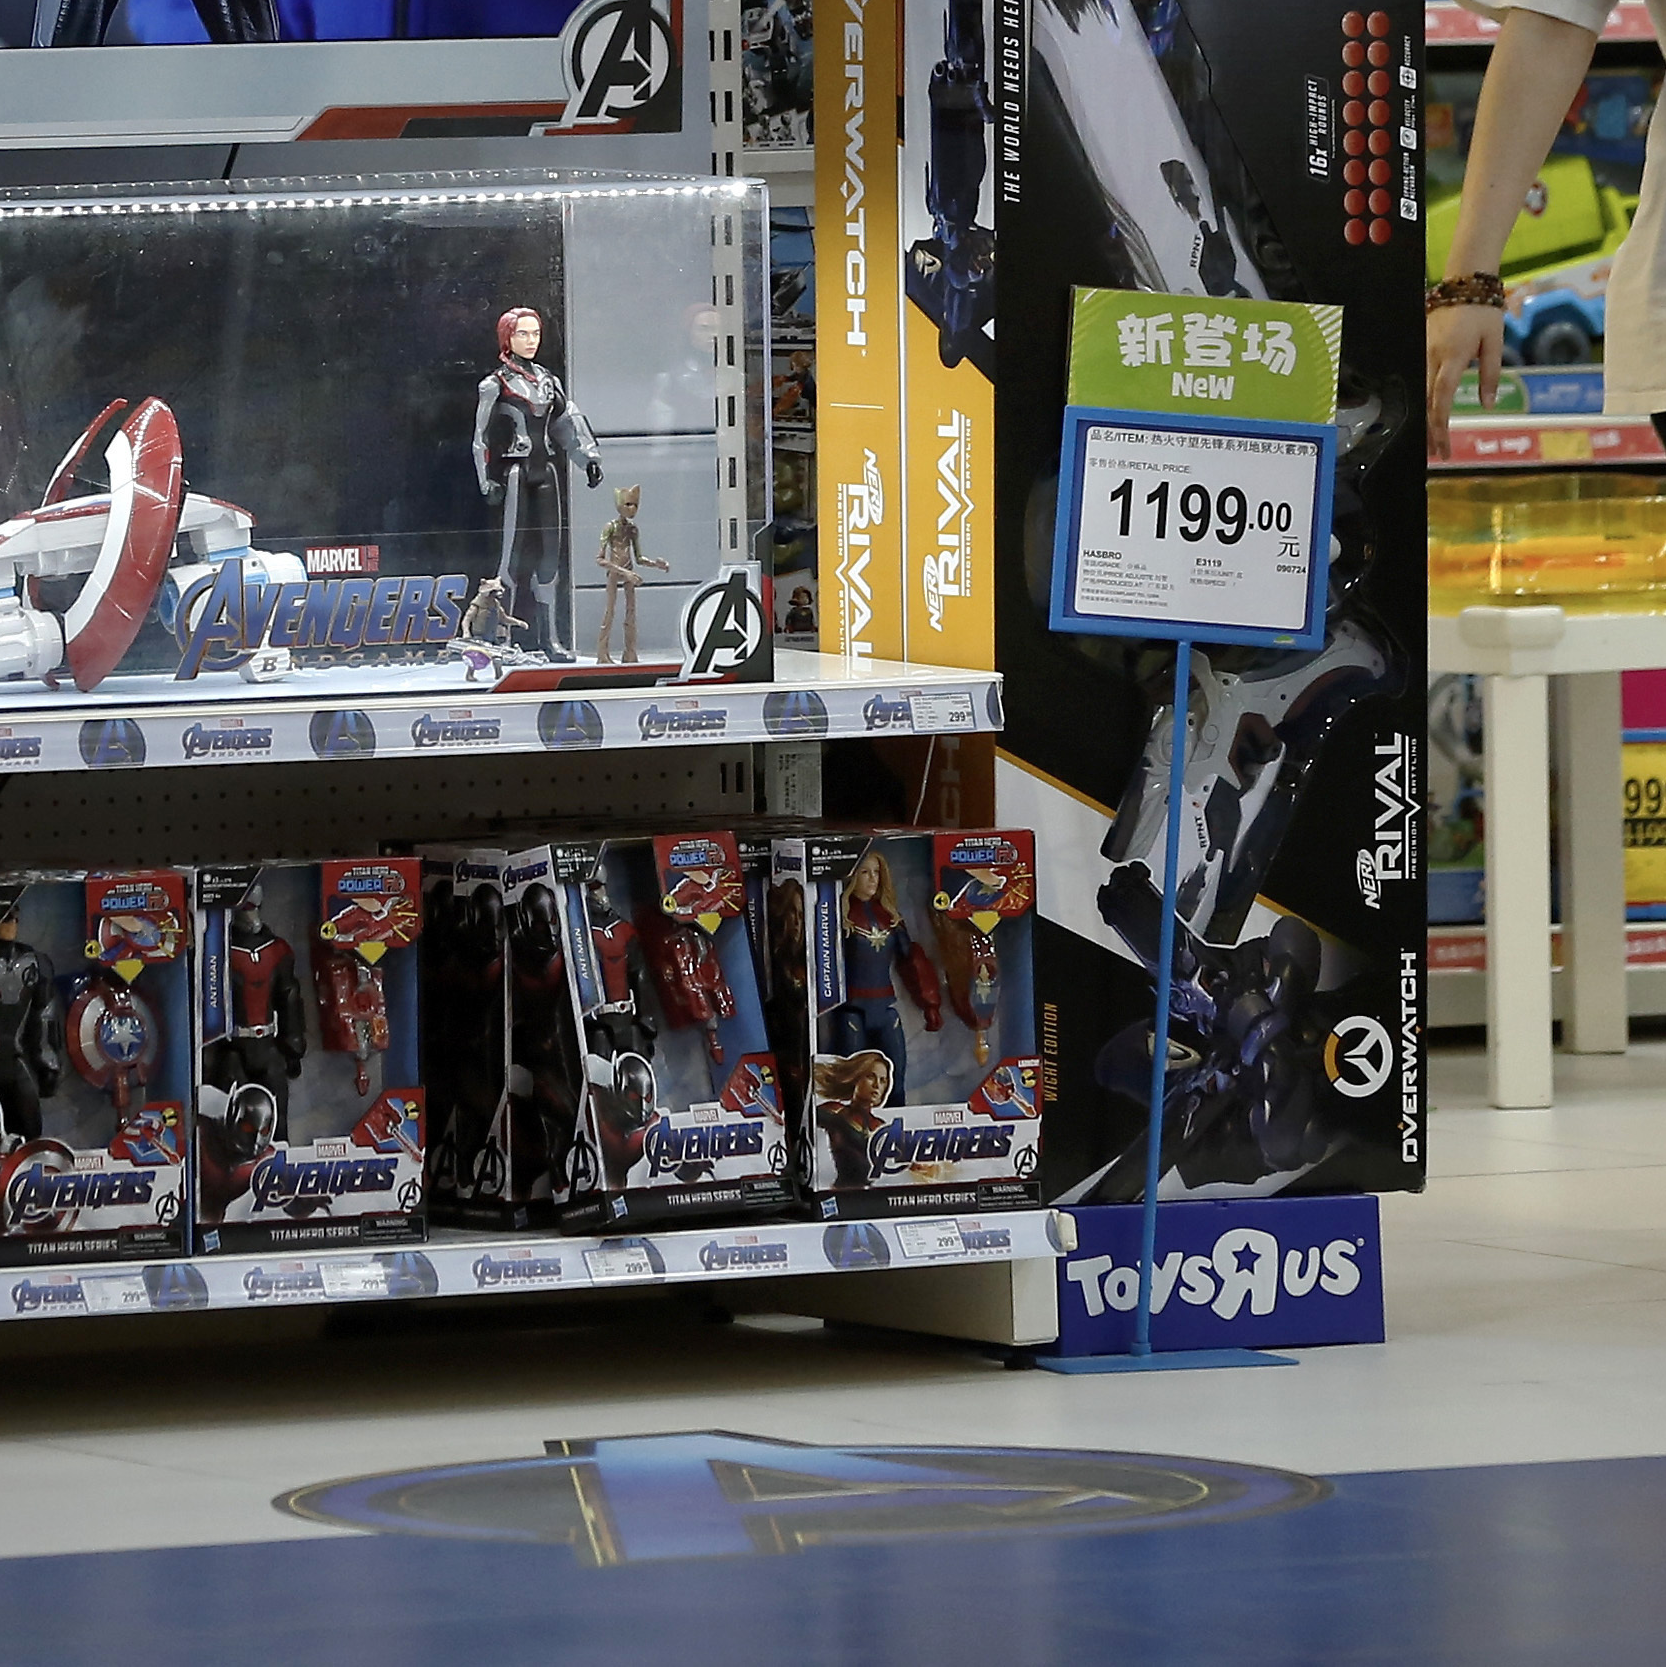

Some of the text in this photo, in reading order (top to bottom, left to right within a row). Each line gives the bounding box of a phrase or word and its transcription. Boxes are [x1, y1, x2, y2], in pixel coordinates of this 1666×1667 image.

[1004, 34, 1021, 98] NEEDS
[1004, 105, 1021, 165] WORLD
[1309, 78, 1317, 147] HIGH-IMPACT
[1318, 94, 1328, 137] ROUNDS
[1004, 171, 1021, 204] THE
[1190, 235, 1201, 268] RPNT
[1116, 311, 1297, 376] 新登场
[861, 448, 882, 524] NERF
[936, 409, 962, 596] RIVAL
[1109, 478, 1292, 546] 1199.00
[307, 548, 361, 571] MARVEL
[1083, 549, 1122, 560] HASBRO
[1196, 558, 1222, 567] E3119
[1277, 564, 1306, 574] 090724
[1278, 535, 1300, 558] 元
[176, 559, 469, 679] AVENGERS
[925, 553, 944, 632] NERF
[1377, 733, 1402, 879] RIVAL
[1410, 738, 1418, 879] PRECISION BATTLING
[950, 850, 994, 863] POWER
[1355, 849, 1380, 908] NERF
[822, 901, 831, 998] CAPTAIN MARVEL
[209, 955, 218, 1008] ANT-MAN
[1045, 1003, 1058, 1102] WIGHT EDITION
[1402, 950, 1418, 1162] OVERWATCH
[935, 1111, 962, 1124] MARVEL
[645, 1118, 763, 1178] AVENGERS
[869, 1123, 1014, 1178] AVENGERS
[10, 1159, 155, 1216] AVENGERS
[253, 1153, 396, 1211] AVENGERS
[888, 1193, 975, 1205] TITAN HERO SERIES
